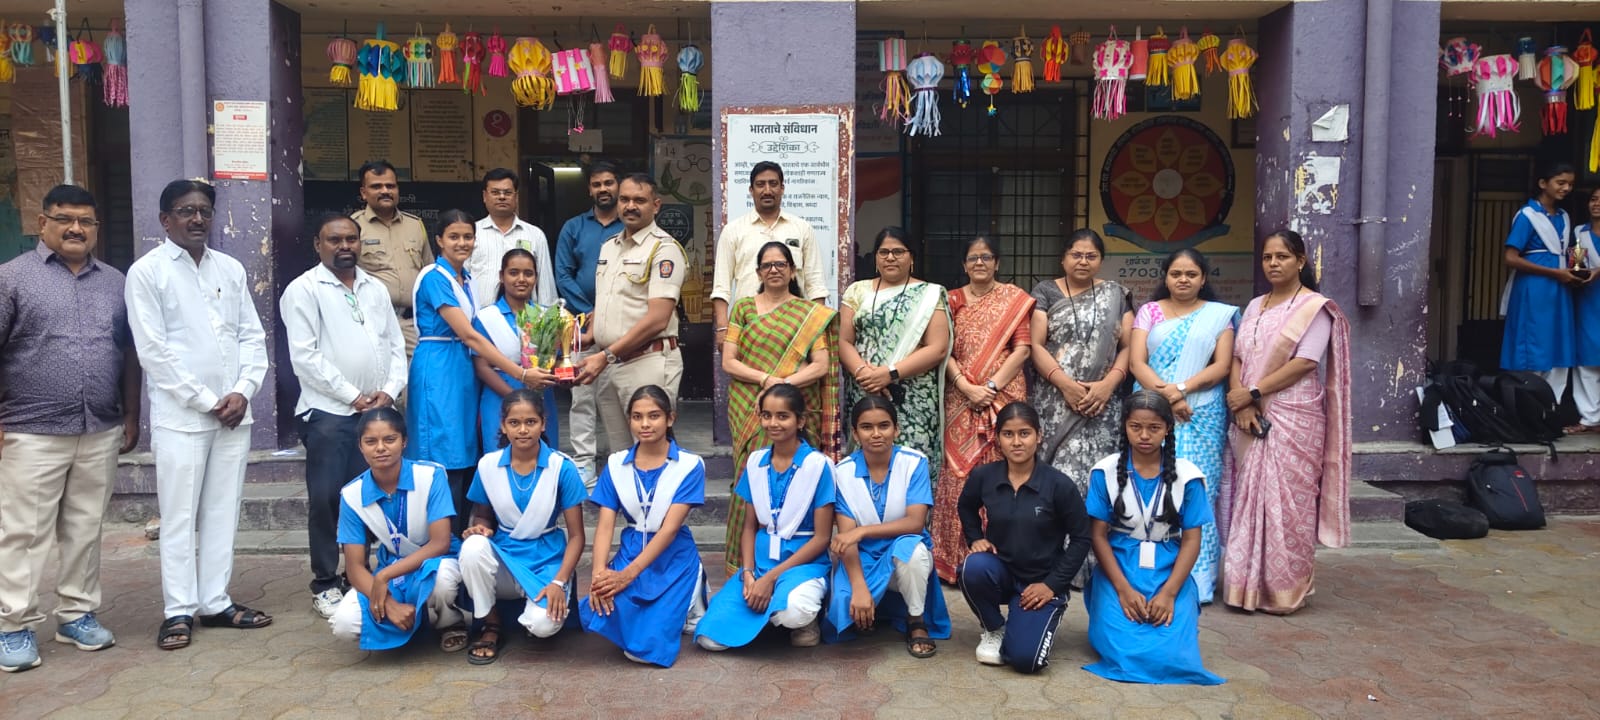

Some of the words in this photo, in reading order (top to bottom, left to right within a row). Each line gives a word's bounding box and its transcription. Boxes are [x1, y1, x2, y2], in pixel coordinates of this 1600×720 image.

[750, 122, 781, 134] भारताचे
[783, 122, 818, 134] संविधान
[767, 142, 801, 153] उद्देशिका
